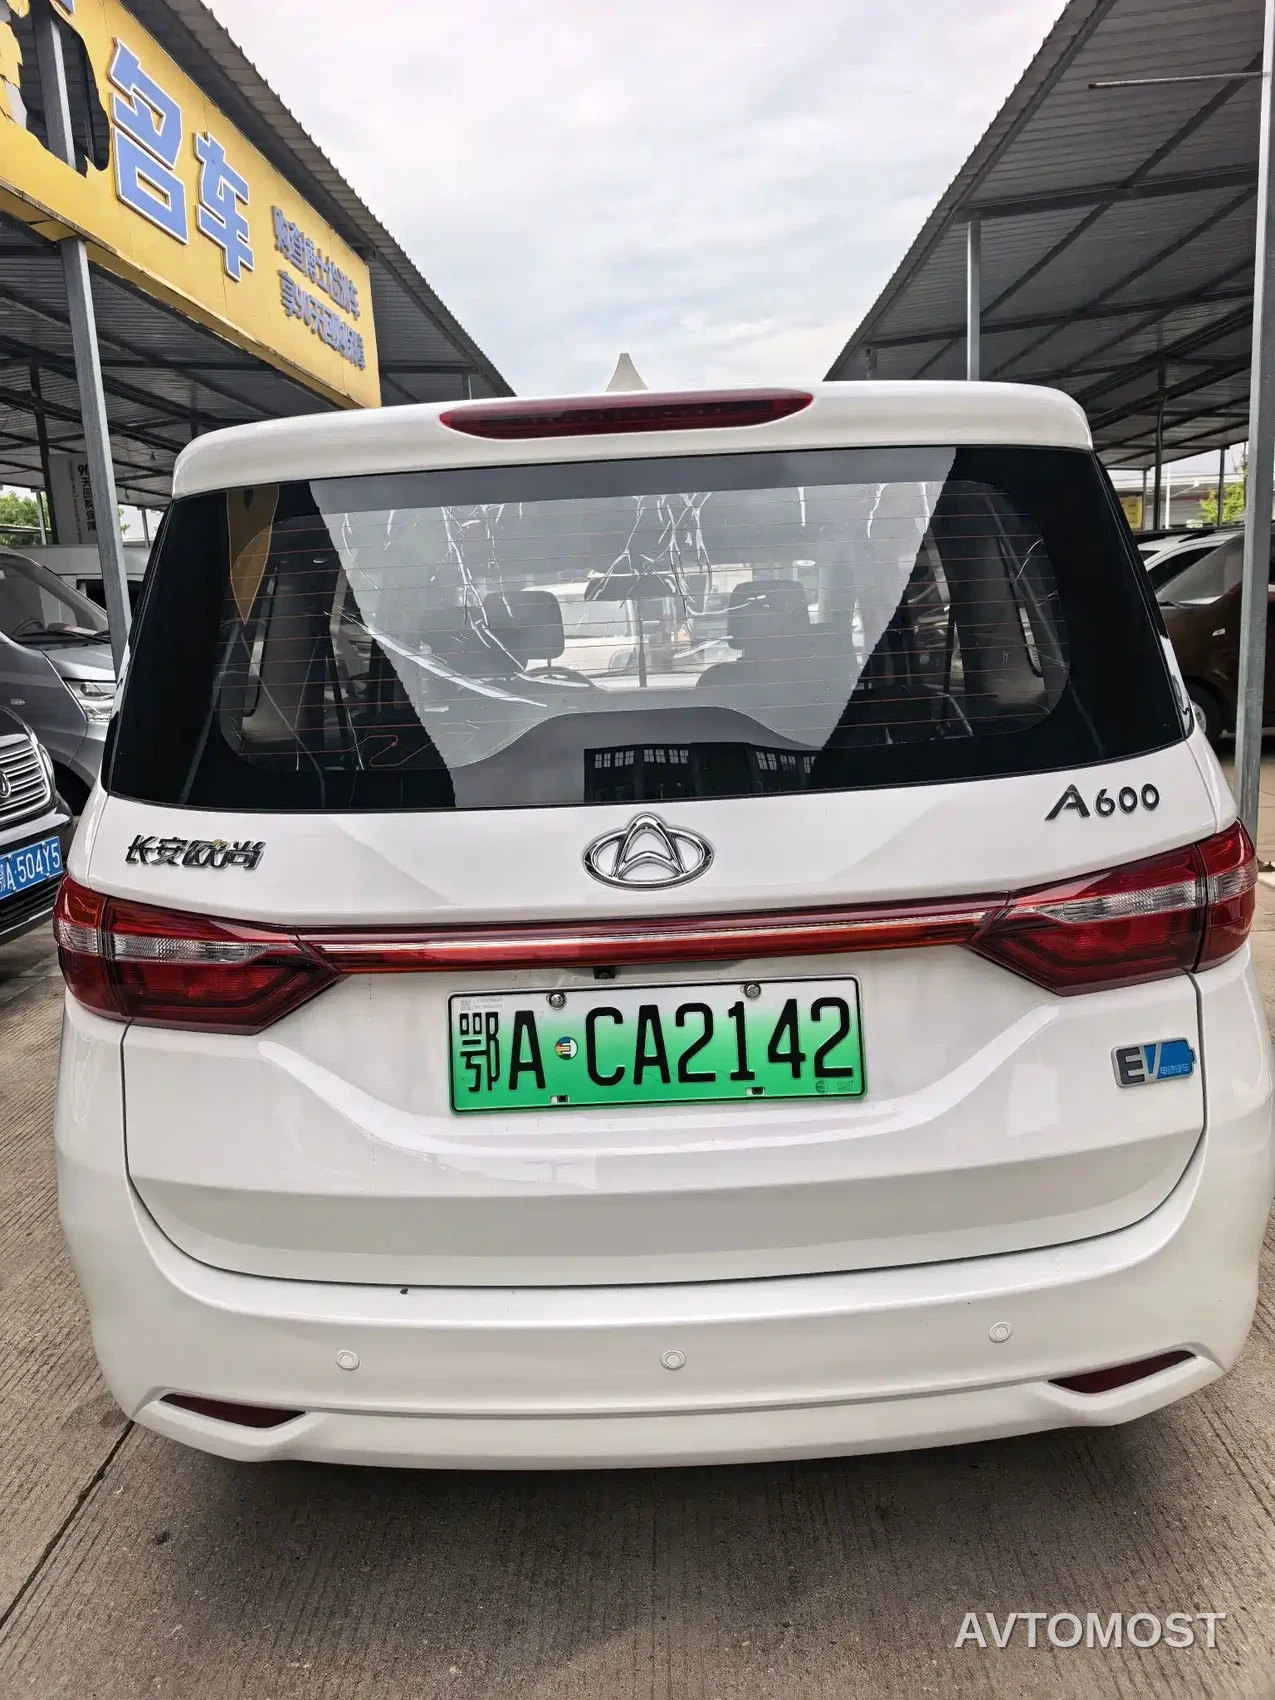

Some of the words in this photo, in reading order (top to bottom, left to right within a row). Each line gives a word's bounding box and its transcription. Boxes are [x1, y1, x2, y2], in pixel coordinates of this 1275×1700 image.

[1045, 783, 1160, 820] A600
[125, 834, 267, 870] 长安欧尚
[1115, 1041, 1162, 1085] EV
